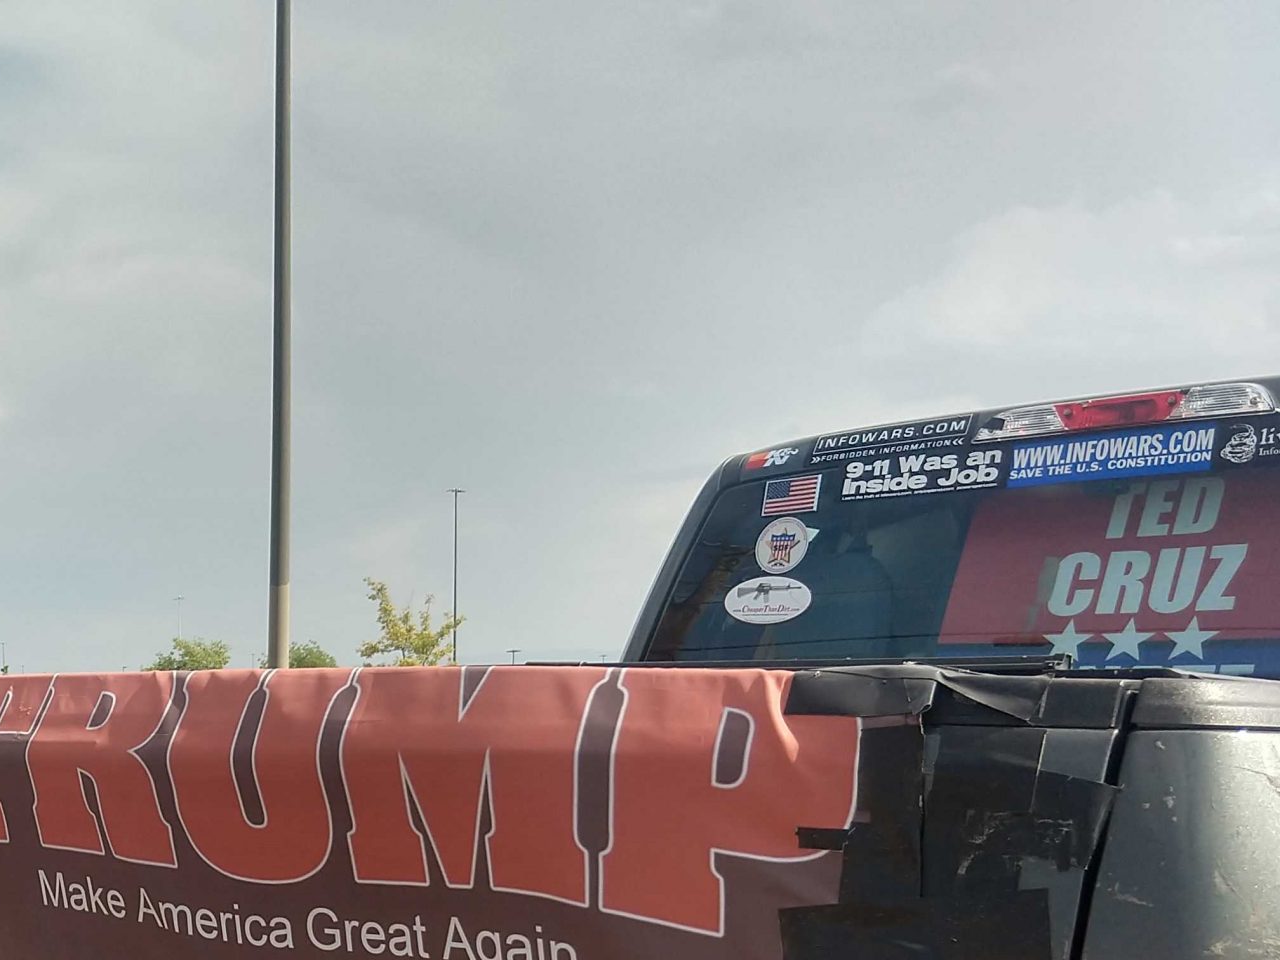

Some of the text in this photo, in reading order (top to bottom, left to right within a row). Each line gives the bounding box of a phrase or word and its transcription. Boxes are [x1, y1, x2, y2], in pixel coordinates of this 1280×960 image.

[817, 420, 966, 449] INFOWARS.COM
[1012, 428, 1216, 469] WWW.INFOWARS.COM
[820, 439, 951, 462] FORBIDDEN INFORMATION
[846, 449, 1003, 479] 9-11 Was an
[1009, 450, 1212, 480] SAVE THE U.S. CONSTITUTION
[841, 473, 928, 496] Inside
[937, 465, 999, 487] Job
[1105, 476, 1226, 540] TED
[1047, 543, 1249, 617] CRUZ
[37, 868, 127, 920] Make
[136, 896, 294, 951] America
[306, 907, 427, 959] Great
